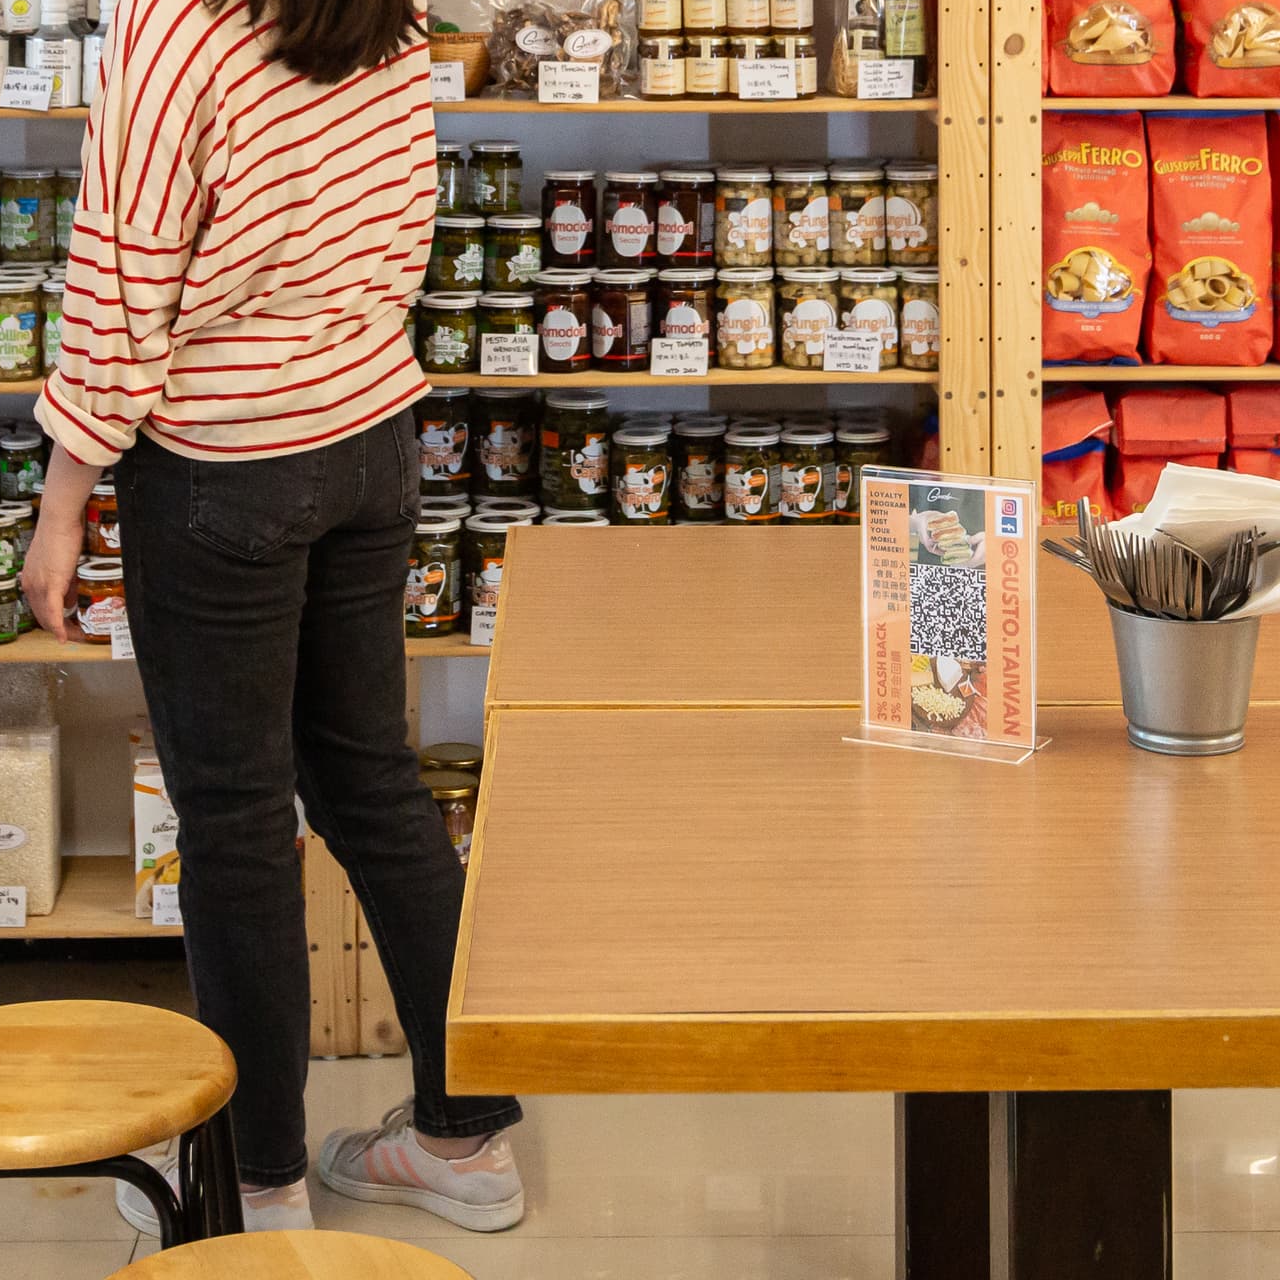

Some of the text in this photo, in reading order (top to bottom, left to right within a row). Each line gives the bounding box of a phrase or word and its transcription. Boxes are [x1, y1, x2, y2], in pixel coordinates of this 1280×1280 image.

[1080, 142, 1142, 168] FERRO
[1154, 148, 1263, 176] GIUSEPPE FERRO
[870, 491, 902, 499] LOYALTY
[878, 622, 887, 656] BACK
[1001, 540, 1020, 736] @GUSTO.TAIWAN
[878, 660, 887, 698] CASH
